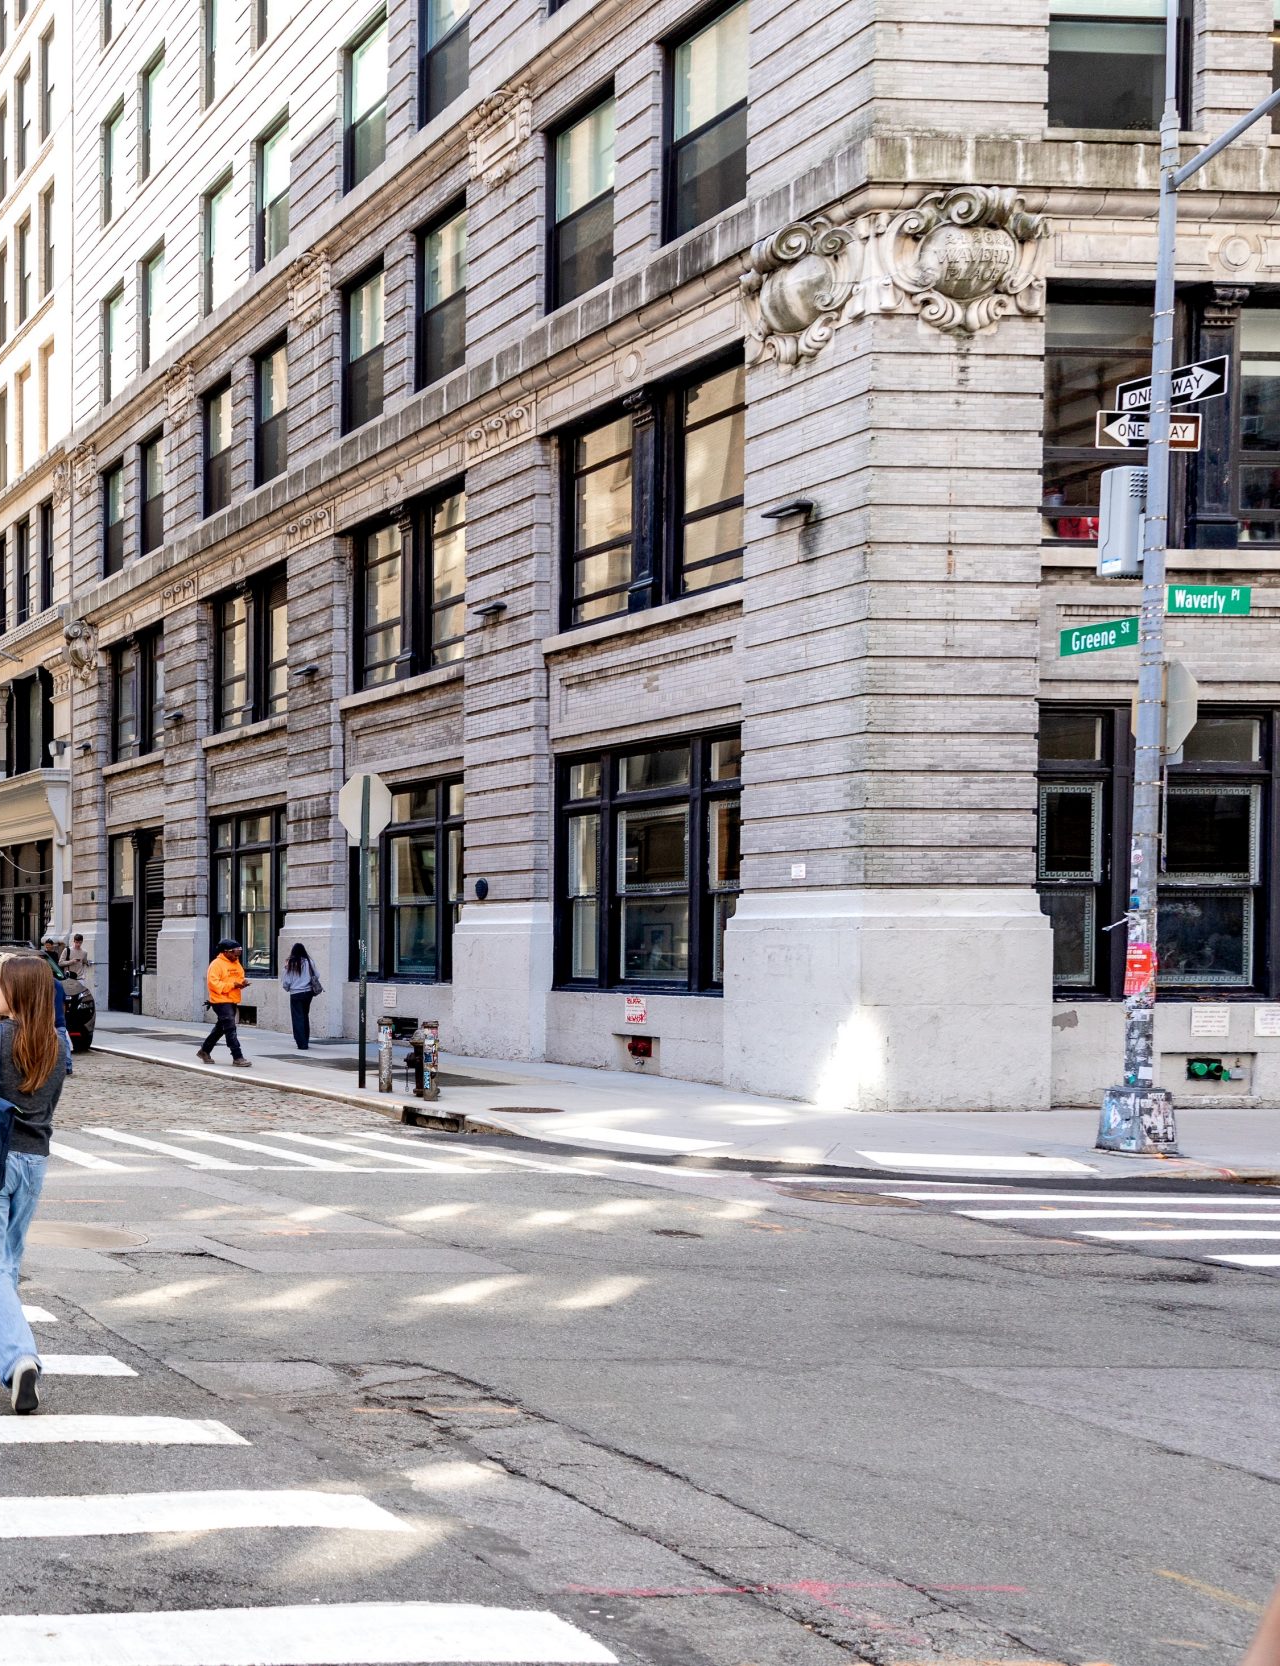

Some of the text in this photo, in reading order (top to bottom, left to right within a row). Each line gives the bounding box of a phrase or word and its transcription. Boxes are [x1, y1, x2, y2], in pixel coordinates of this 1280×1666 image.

[944, 268, 999, 281] PLACE
[1172, 374, 1204, 395] WAY
[1118, 424, 1189, 439] ONE AY
[1174, 588, 1240, 613] Waverly Pl
[1071, 621, 1130, 652] Greene St
